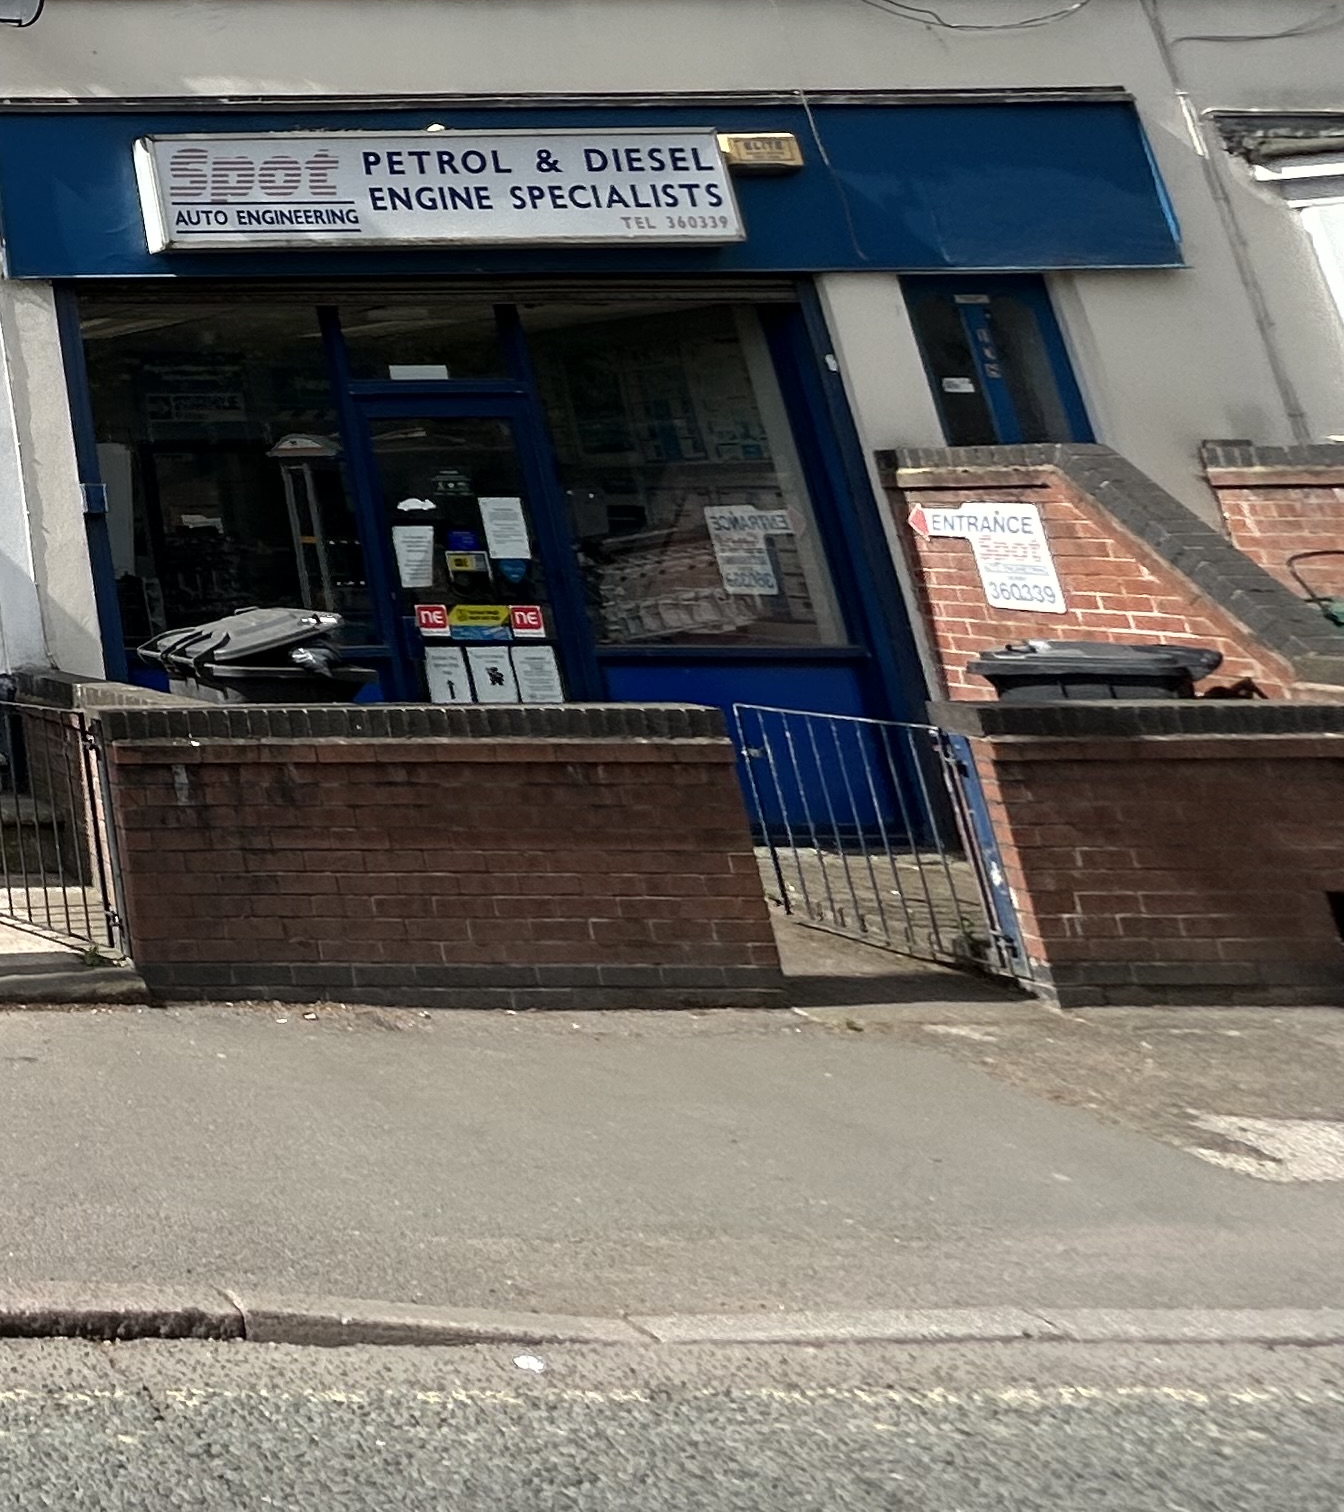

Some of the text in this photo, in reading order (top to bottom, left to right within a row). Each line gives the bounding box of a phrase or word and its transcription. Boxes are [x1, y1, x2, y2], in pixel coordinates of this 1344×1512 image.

[362, 148, 715, 175] PETROL & DIESEL
[368, 183, 723, 211] ENGINE SPECIALISTS
[175, 209, 359, 225] AUTO ENGINEERING
[621, 215, 728, 229] TEL 360339
[931, 514, 1034, 534] ENTRANCE
[988, 581, 1056, 604] 360339
